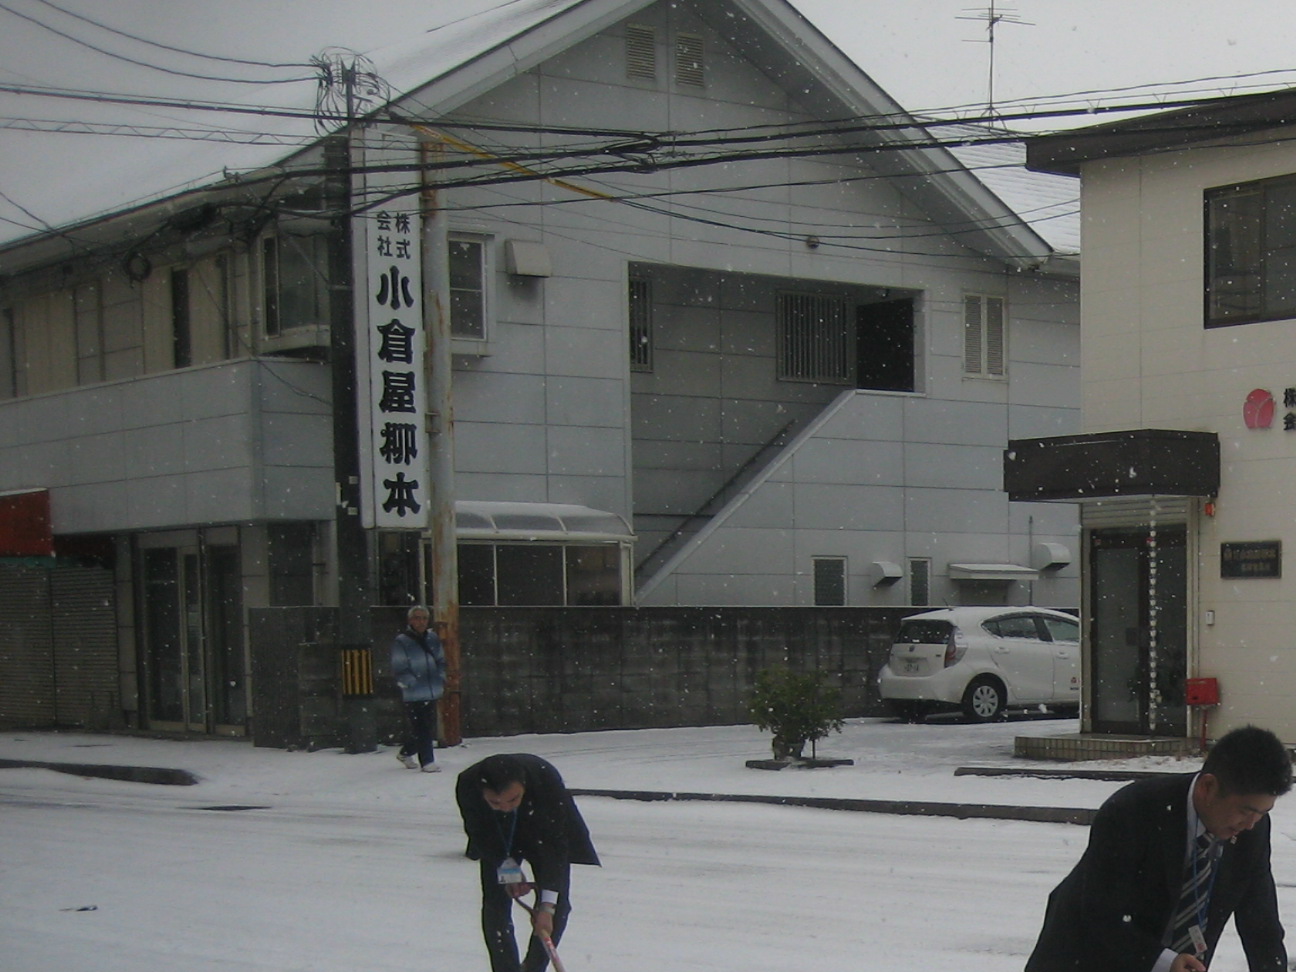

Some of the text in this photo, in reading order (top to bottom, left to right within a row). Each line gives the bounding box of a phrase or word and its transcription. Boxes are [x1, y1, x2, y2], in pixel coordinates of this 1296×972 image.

[376, 265, 421, 517] 小倉屋柳本
